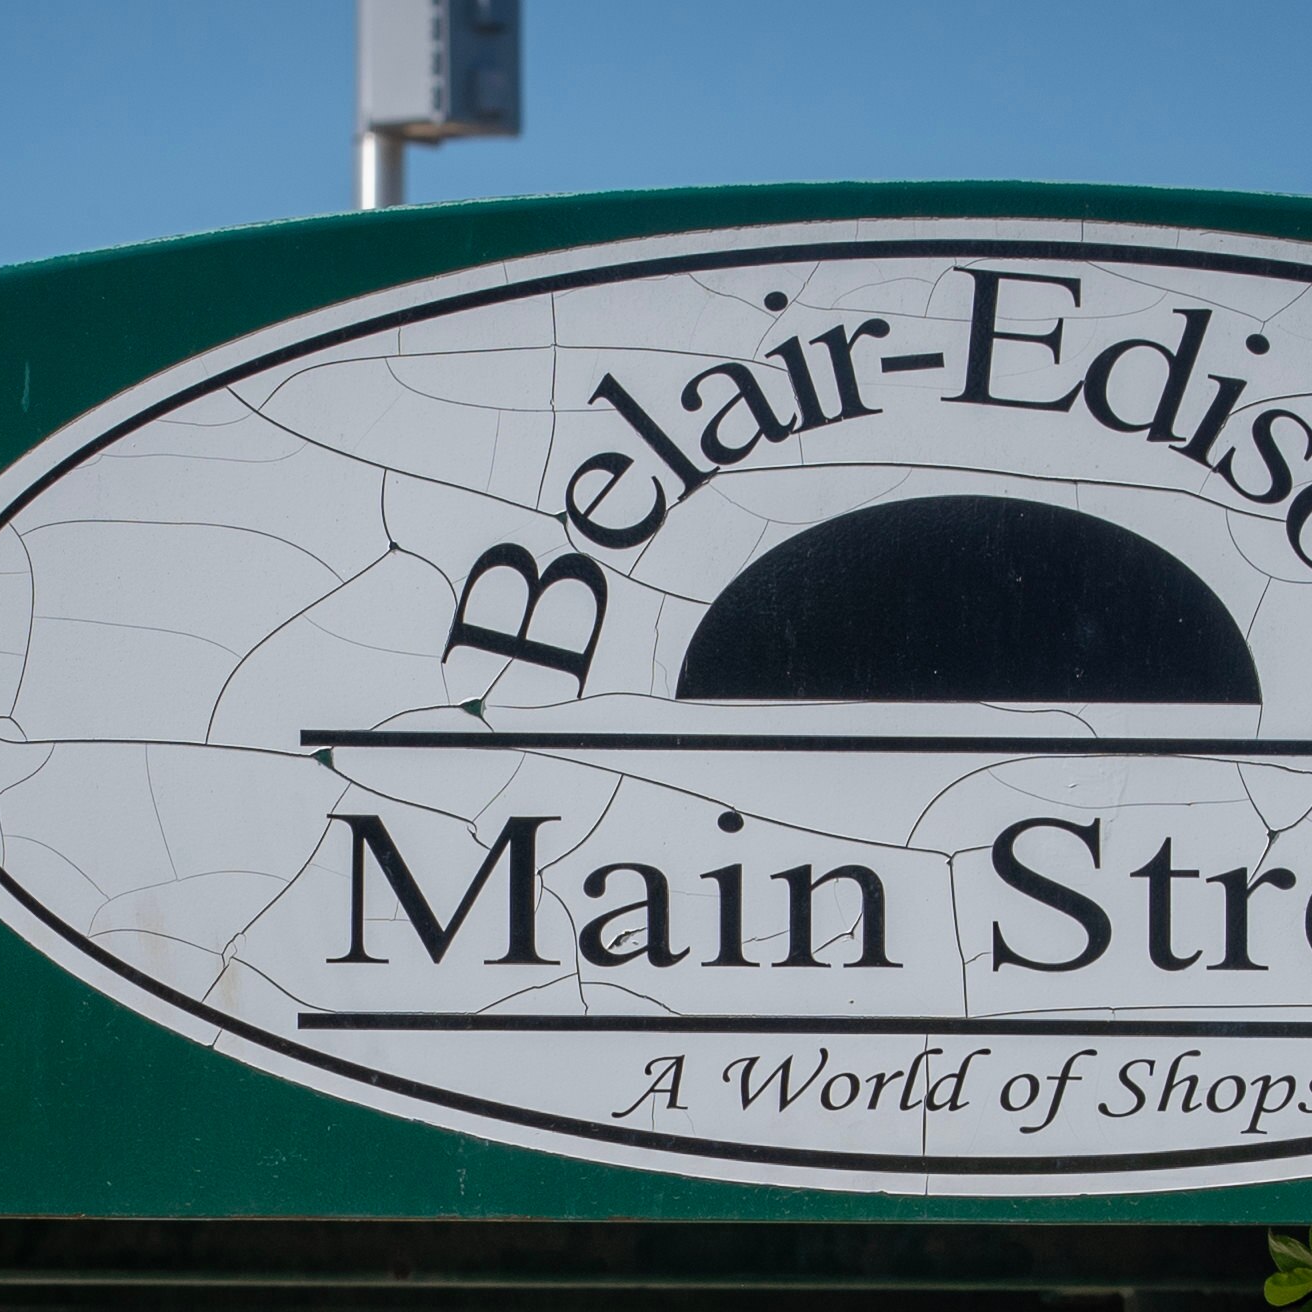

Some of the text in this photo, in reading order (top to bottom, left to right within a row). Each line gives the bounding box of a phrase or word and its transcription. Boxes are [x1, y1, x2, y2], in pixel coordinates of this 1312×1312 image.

[325, 811, 905, 969] Main
[611, 1052, 688, 1119] A
[722, 1046, 992, 1113] World
[999, 1048, 1098, 1135] of
